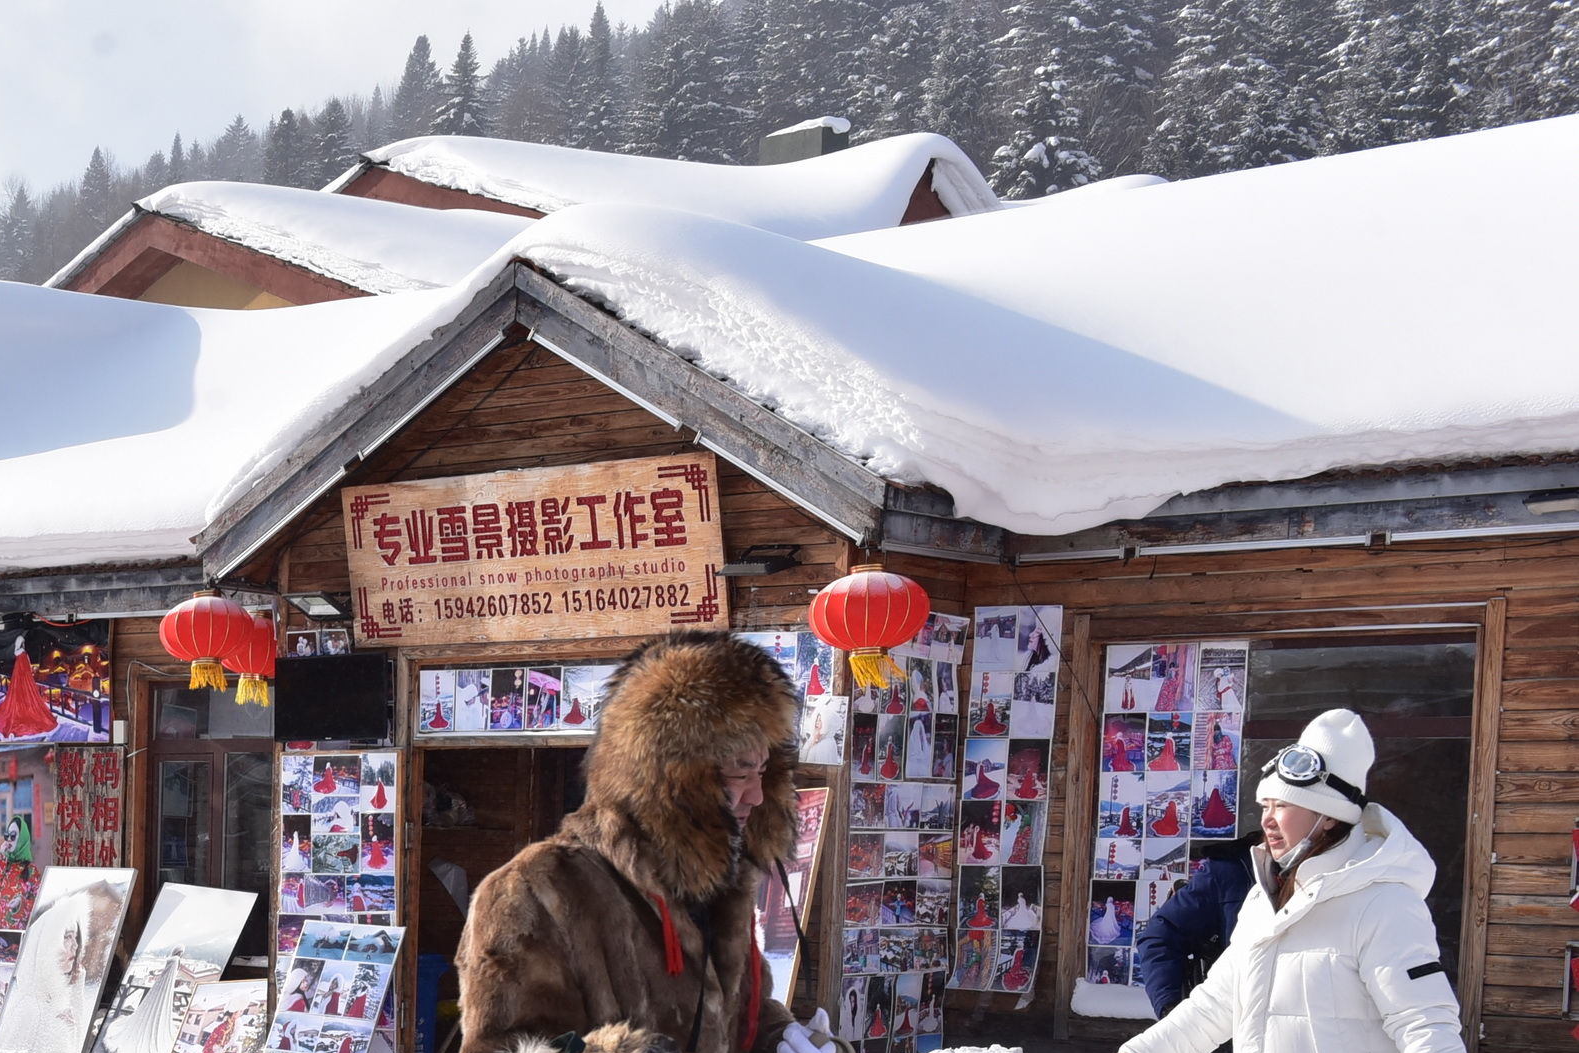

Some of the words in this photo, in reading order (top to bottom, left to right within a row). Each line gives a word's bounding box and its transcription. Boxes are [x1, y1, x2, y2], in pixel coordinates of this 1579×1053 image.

[373, 488, 688, 566] 专业雪景摄影工作室
[381, 572, 472, 592] Professional
[479, 572, 517, 585] snow
[525, 563, 626, 587] photography
[633, 559, 687, 576] studio
[434, 591, 554, 620] 15942607852
[561, 583, 691, 613] 15164027882
[58, 751, 120, 789] 数码
[56, 795, 120, 832] 快相
[55, 837, 118, 867] 洗相处
